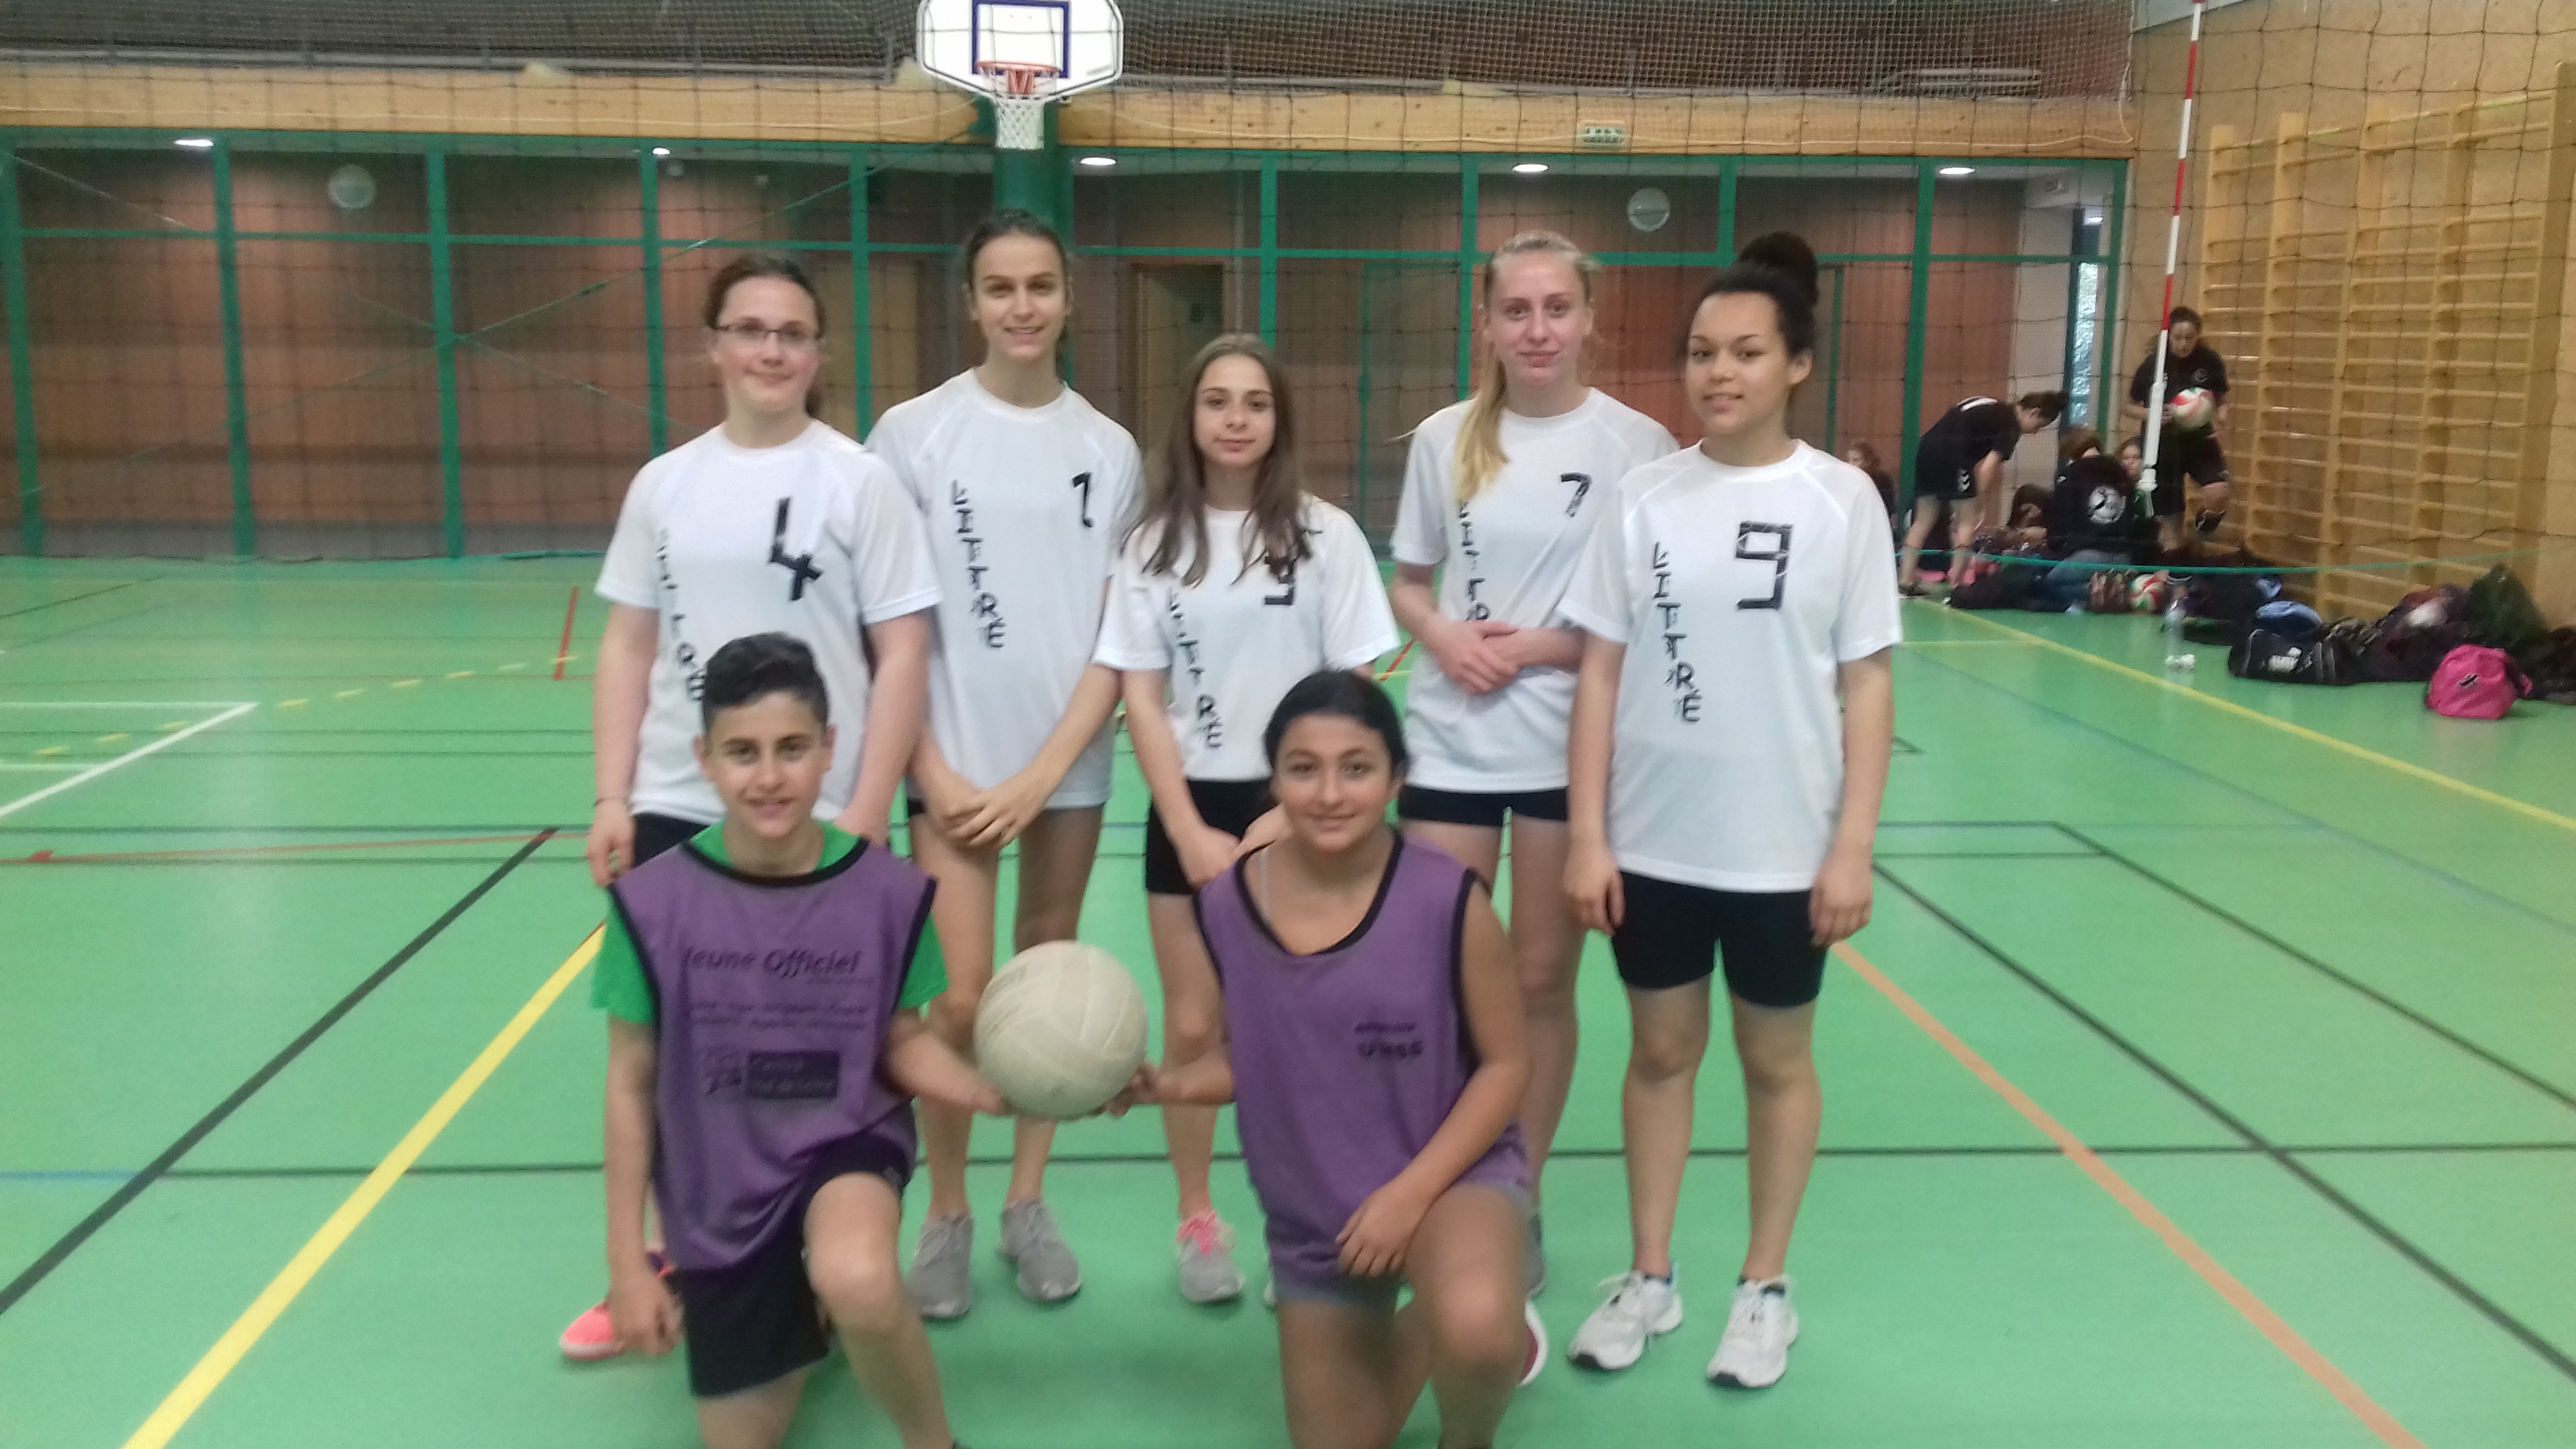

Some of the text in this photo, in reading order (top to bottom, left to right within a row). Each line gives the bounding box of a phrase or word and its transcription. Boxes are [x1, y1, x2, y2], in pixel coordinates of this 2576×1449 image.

[1559, 472, 1592, 518] 7
[768, 496, 823, 601] 4
[1735, 520, 1794, 611] 9
[1653, 541, 1703, 723] LITTRÉ
[762, 947, 862, 979] Officiel
